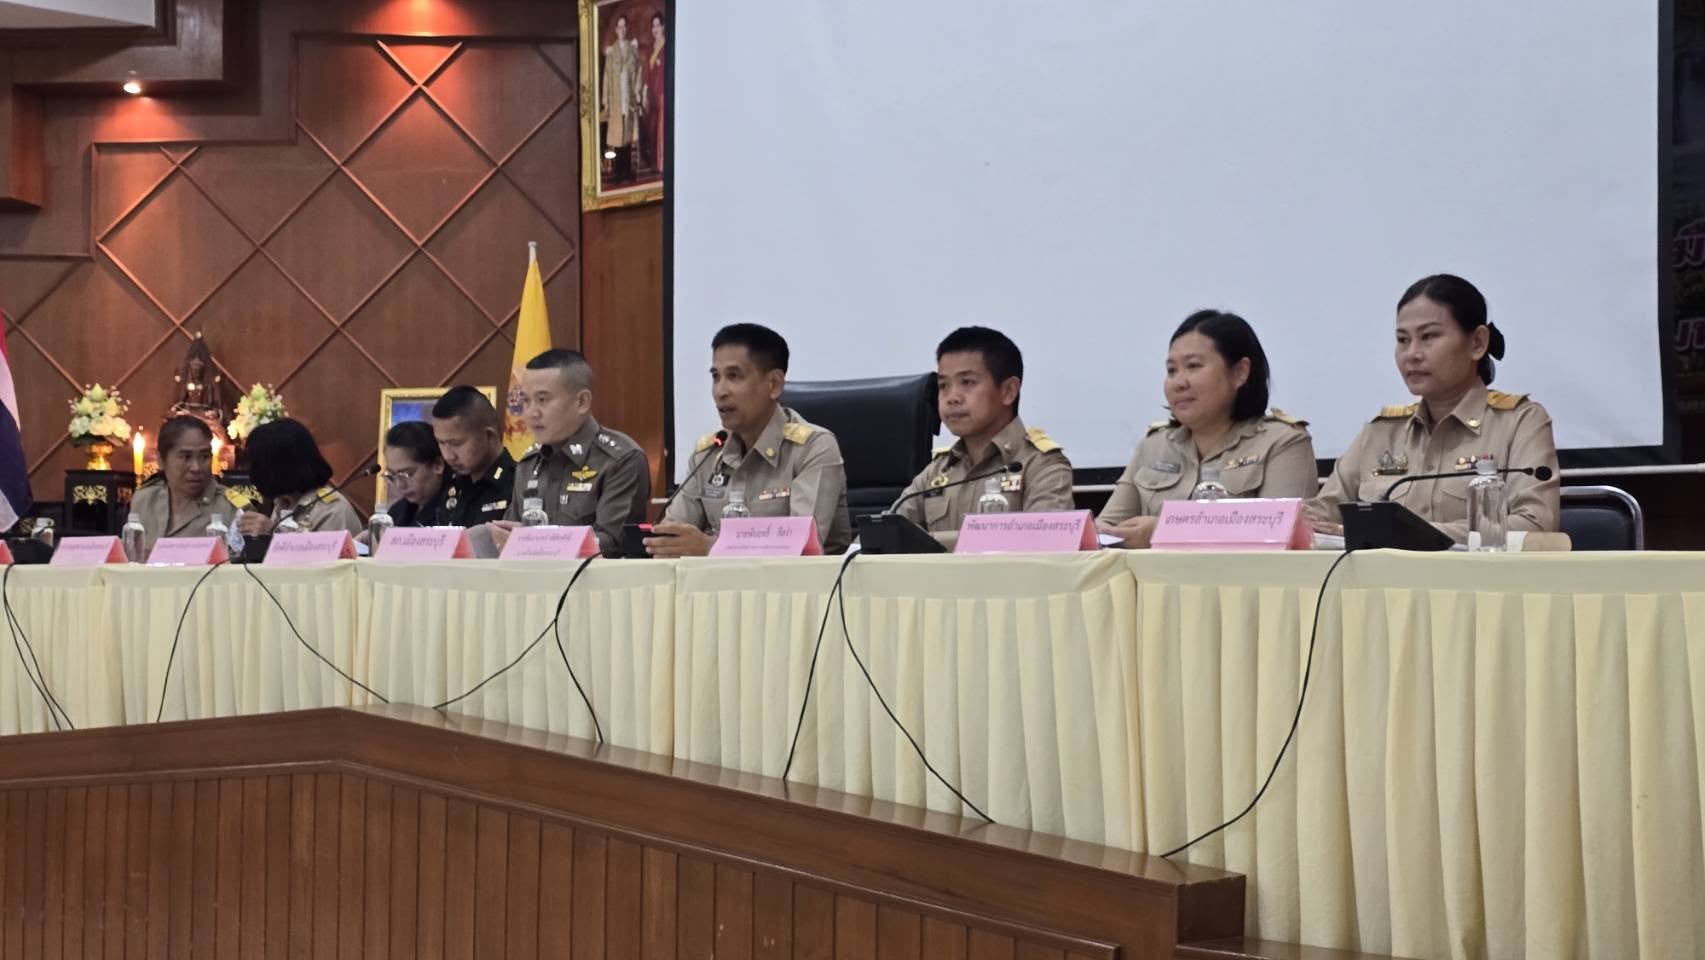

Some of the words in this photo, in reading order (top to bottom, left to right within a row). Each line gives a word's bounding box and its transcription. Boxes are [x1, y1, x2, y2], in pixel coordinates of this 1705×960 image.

[1165, 510, 1285, 531] เกษตรอำเภอเมืองสระบุรี
